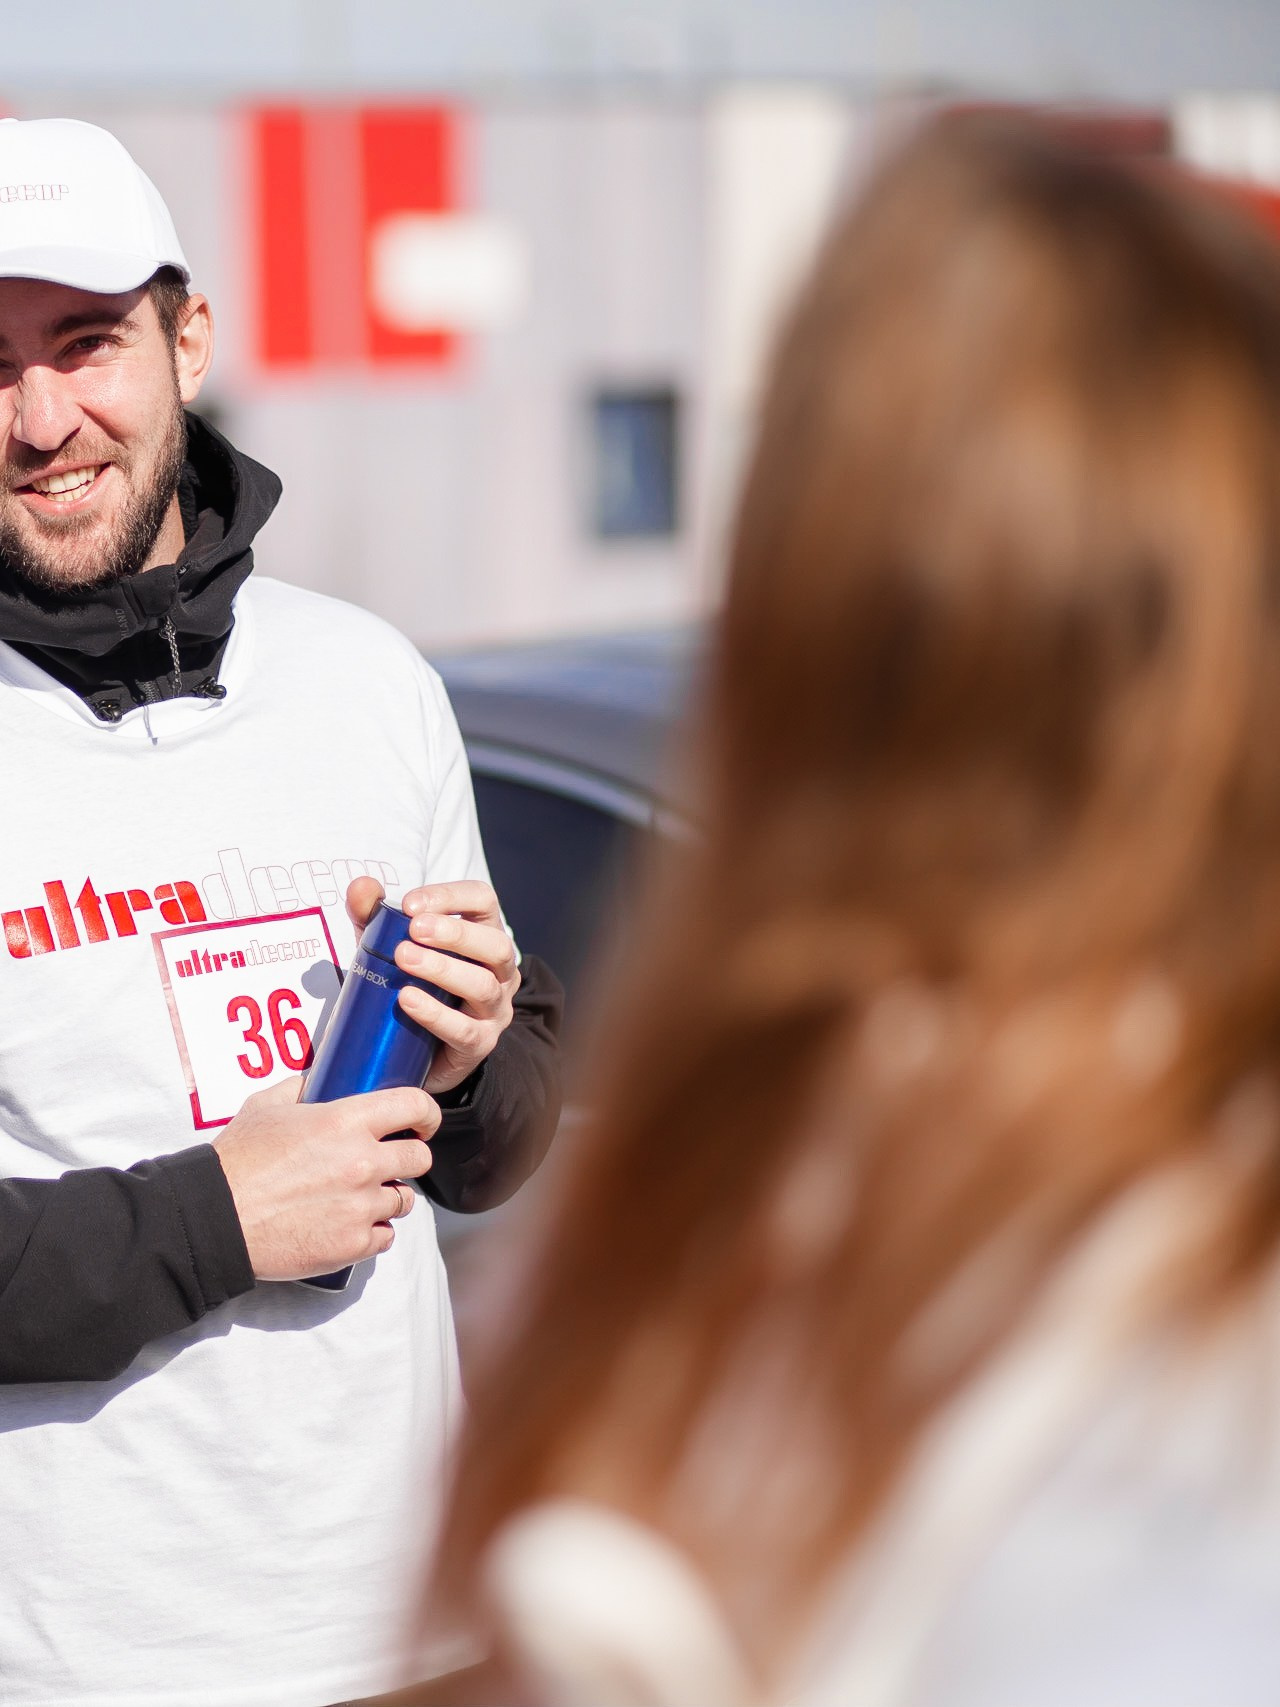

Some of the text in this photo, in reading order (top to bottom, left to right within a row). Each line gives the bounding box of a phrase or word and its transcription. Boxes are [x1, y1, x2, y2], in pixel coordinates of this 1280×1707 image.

[174, 939, 321, 978] ultradecor
[366, 970, 389, 988] BOX
[226, 987, 316, 1079] 36
